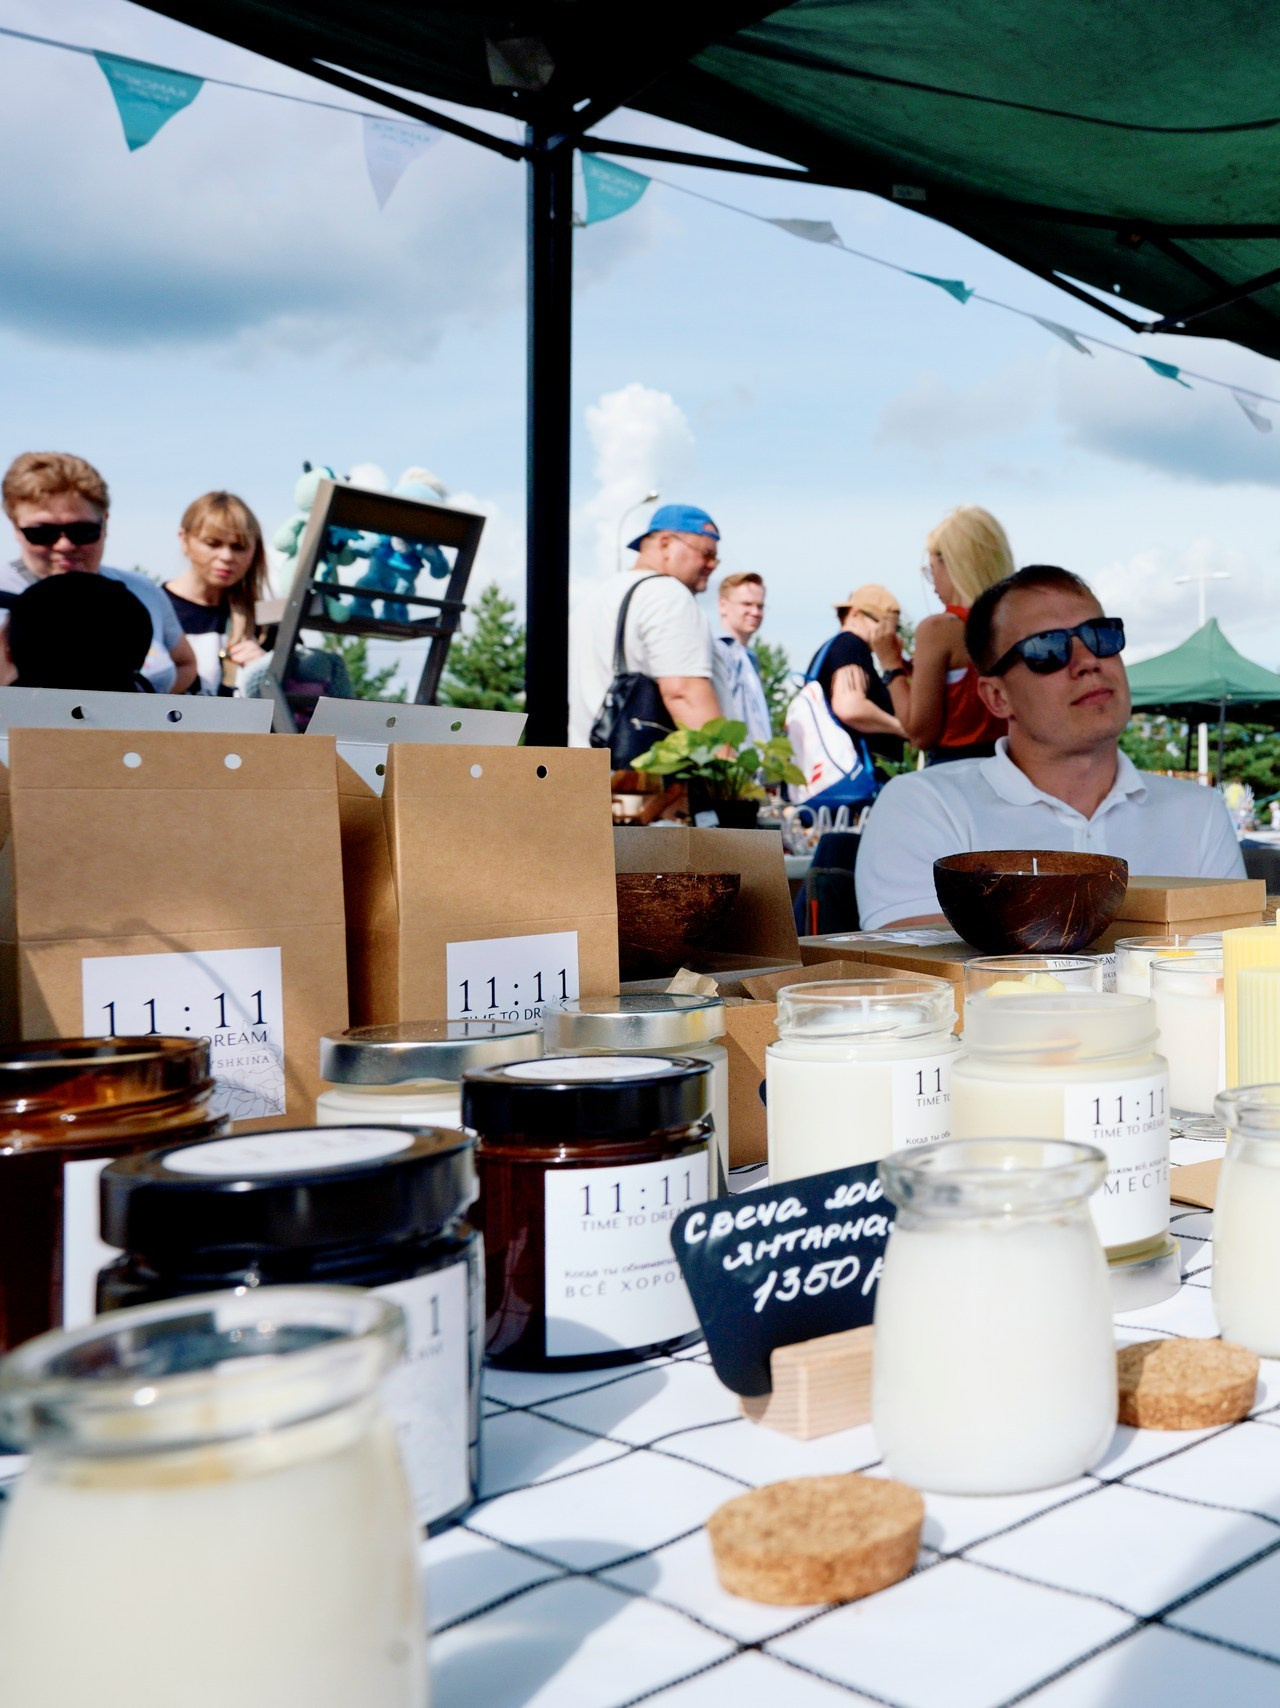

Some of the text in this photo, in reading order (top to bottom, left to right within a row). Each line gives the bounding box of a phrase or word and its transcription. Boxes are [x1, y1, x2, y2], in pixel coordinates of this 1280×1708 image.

[459, 968, 570, 1012] 11:11
[102, 989, 267, 1037] 11:11
[211, 1055, 270, 1069] SHKINA
[916, 1095, 940, 1107] TIME
[1092, 1086, 1164, 1125] 11:11
[1093, 1127, 1121, 1138] TIME
[1127, 1125, 1140, 1135] TO
[906, 1137, 928, 1145] Когда
[579, 1170, 693, 1216] 11:11
[581, 1219, 620, 1232] TIME
[627, 1215, 646, 1228] TO
[684, 1196, 808, 1244] Свеча
[565, 1269, 598, 1279] Когда
[565, 1281, 608, 1299] ВСЁ
[753, 1255, 860, 1313] 1350
